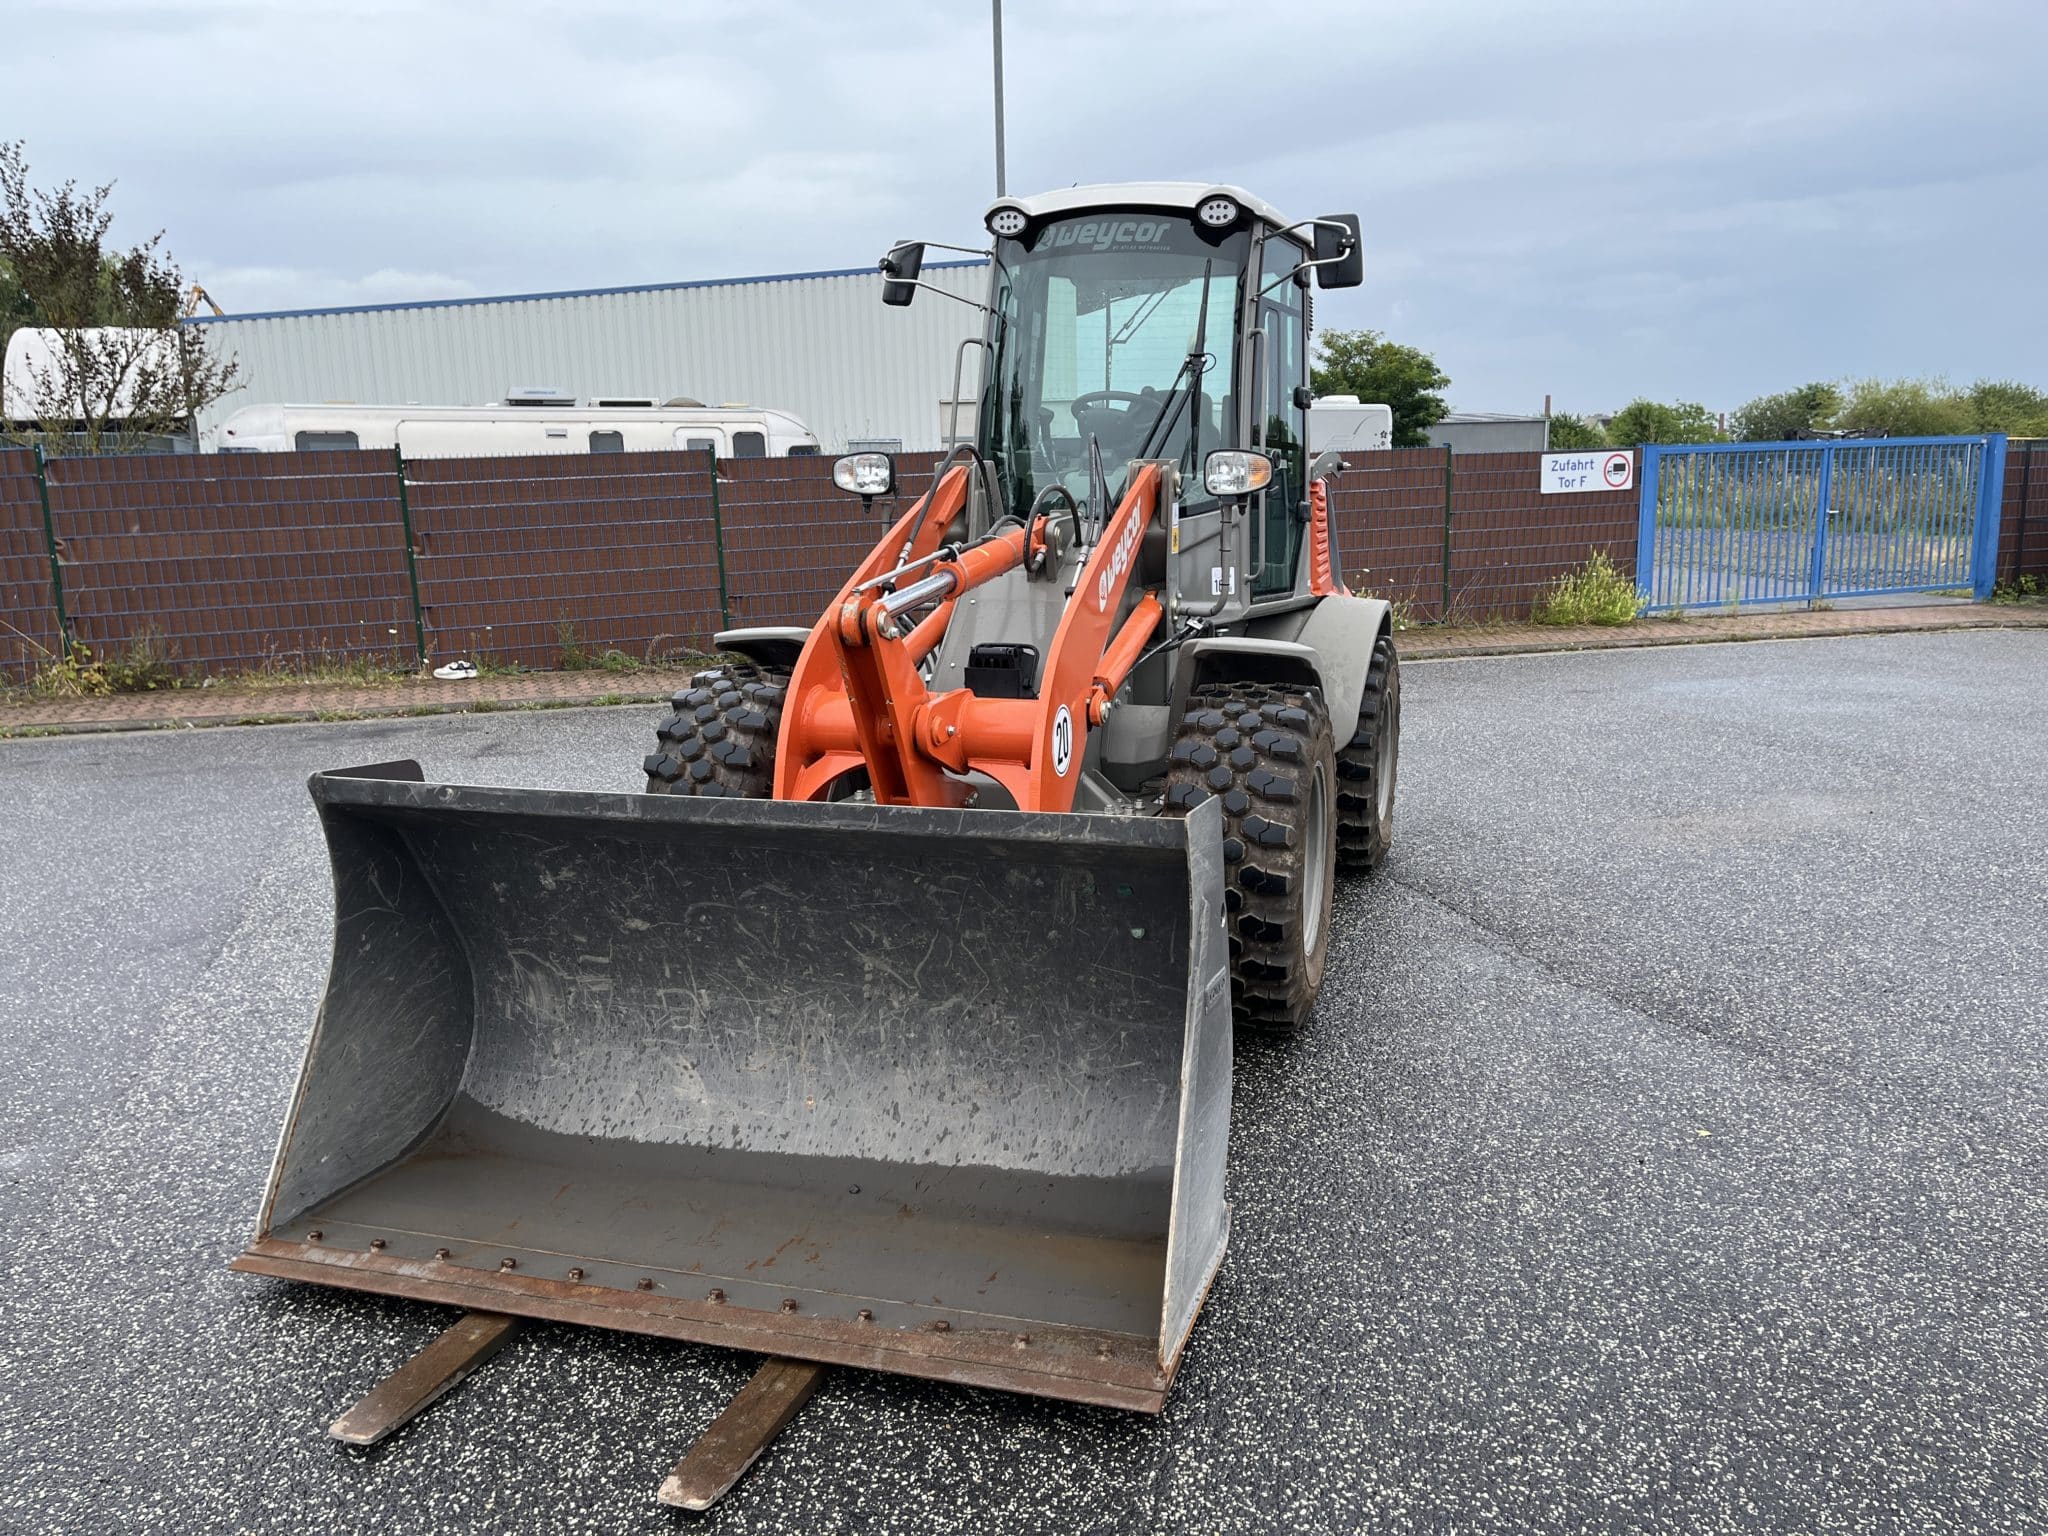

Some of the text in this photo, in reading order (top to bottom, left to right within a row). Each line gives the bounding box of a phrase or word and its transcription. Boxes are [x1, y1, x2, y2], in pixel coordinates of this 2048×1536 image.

[1055, 222, 1171, 251] weycor
[1551, 459, 1595, 472] Zufahrt
[1558, 476, 1587, 488] Tor F
[1106, 496, 1141, 595] weycor
[1056, 716, 1069, 766] 20
